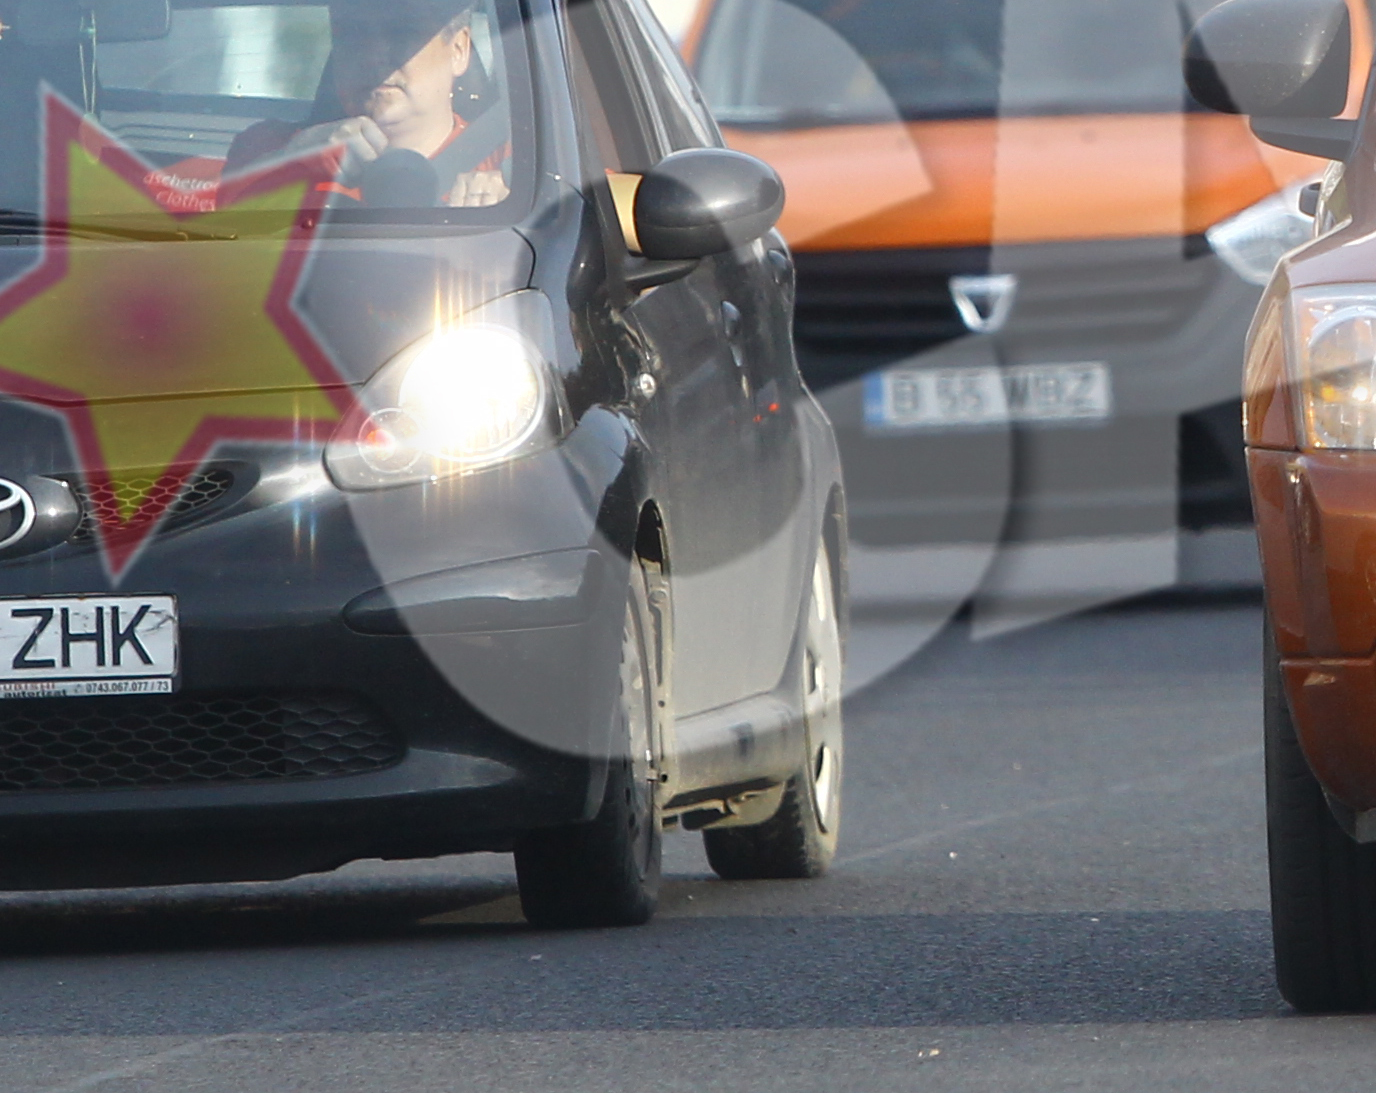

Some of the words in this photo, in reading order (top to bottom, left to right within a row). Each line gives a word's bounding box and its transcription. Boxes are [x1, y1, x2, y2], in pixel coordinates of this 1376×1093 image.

[892, 376, 919, 414] B
[935, 375, 985, 414] 55
[11, 604, 154, 670] ZHK
